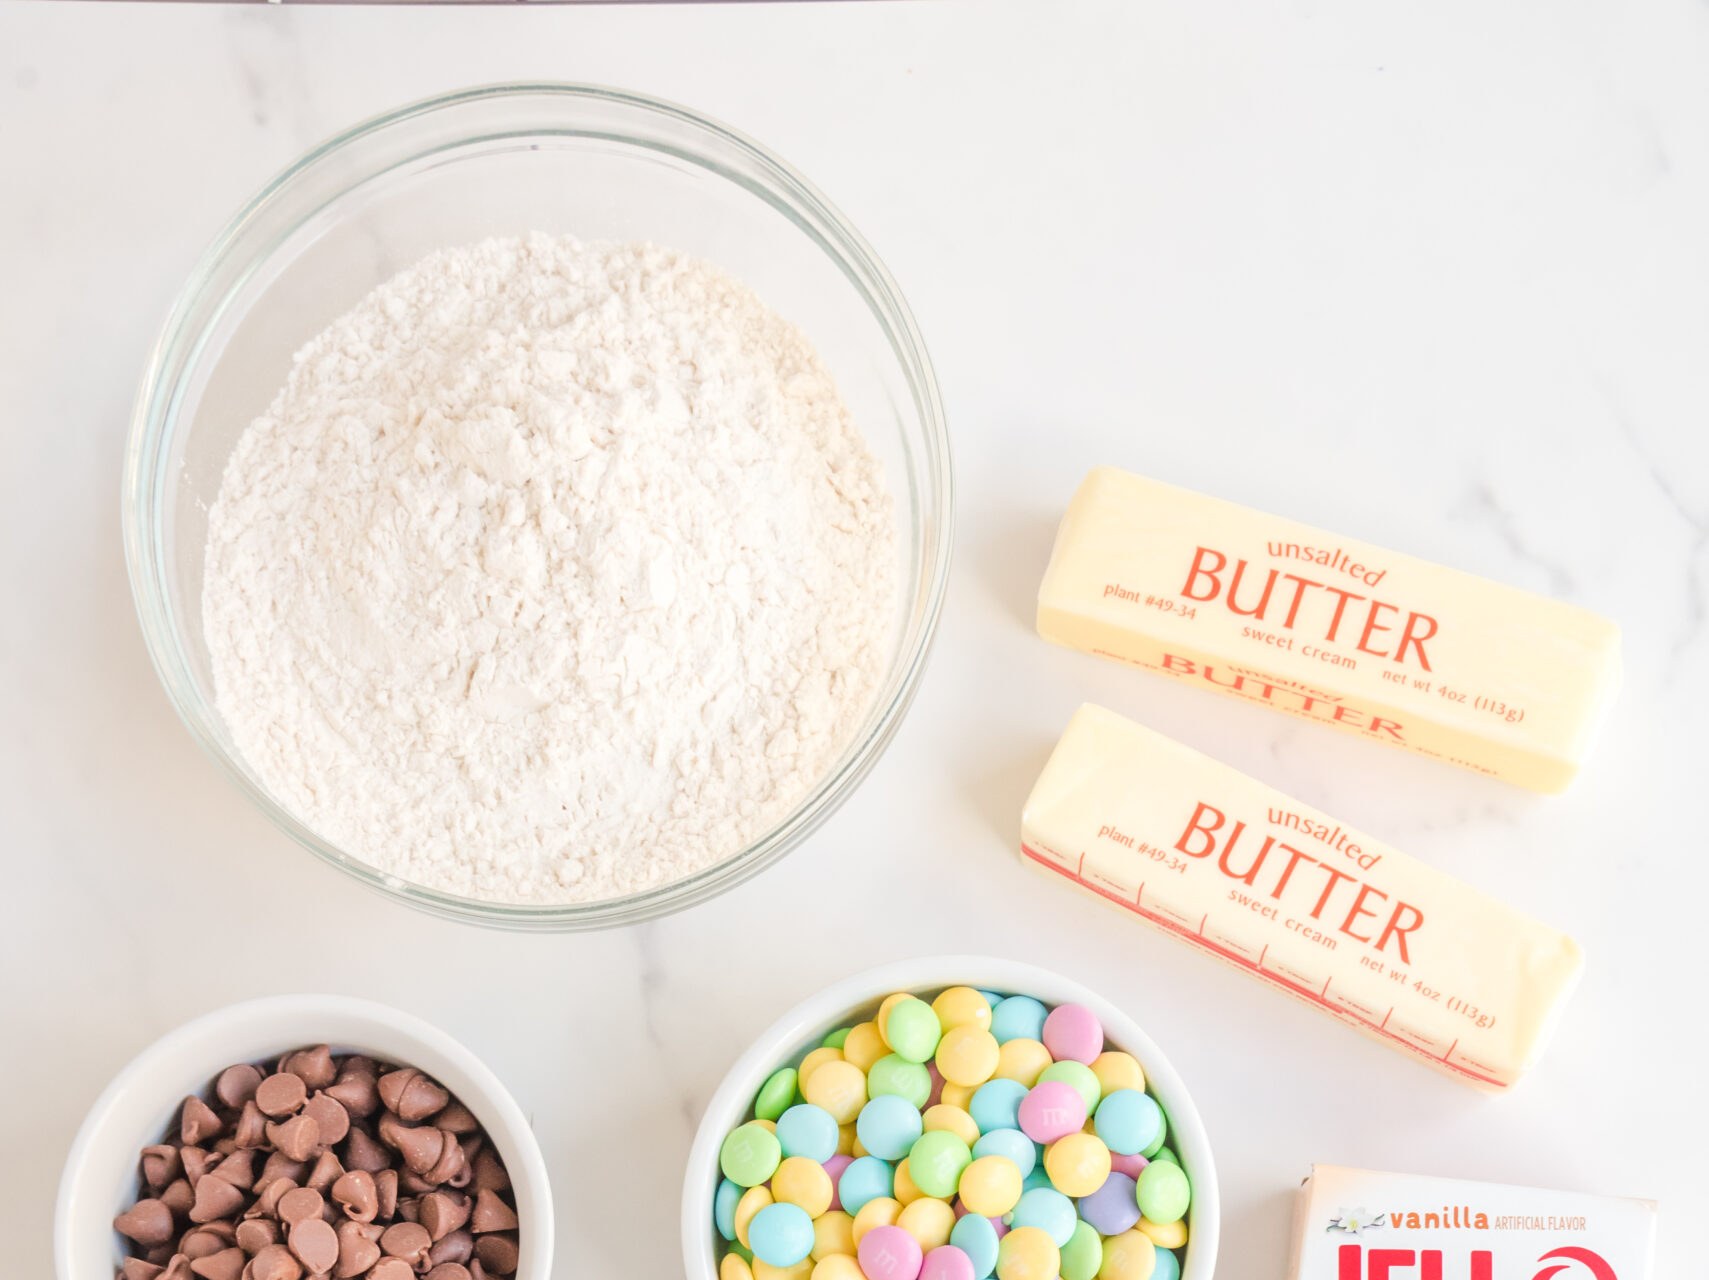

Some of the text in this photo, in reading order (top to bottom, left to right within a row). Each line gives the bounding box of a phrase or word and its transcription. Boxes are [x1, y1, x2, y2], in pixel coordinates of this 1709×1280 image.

[1267, 541, 1387, 588] unsalted
[1103, 583, 1197, 621] plant #49-34
[1180, 546, 1439, 673] BUTTER
[1241, 626, 1357, 670] sweet cream
[1161, 653, 1406, 741] BUTTER
[1382, 669, 1525, 723] net wt 4oz (113g)
[1098, 825, 1188, 875] plant #49-34
[1268, 807, 1382, 871] unsalted
[1174, 801, 1425, 966] BUTTER
[1228, 889, 1279, 921] sweet
[1284, 916, 1338, 951] cream
[1360, 955, 1496, 1030] net wt 4oz (113g)
[1390, 1206, 1586, 1231] vanilla ARTIFICIAL FLAVOR
